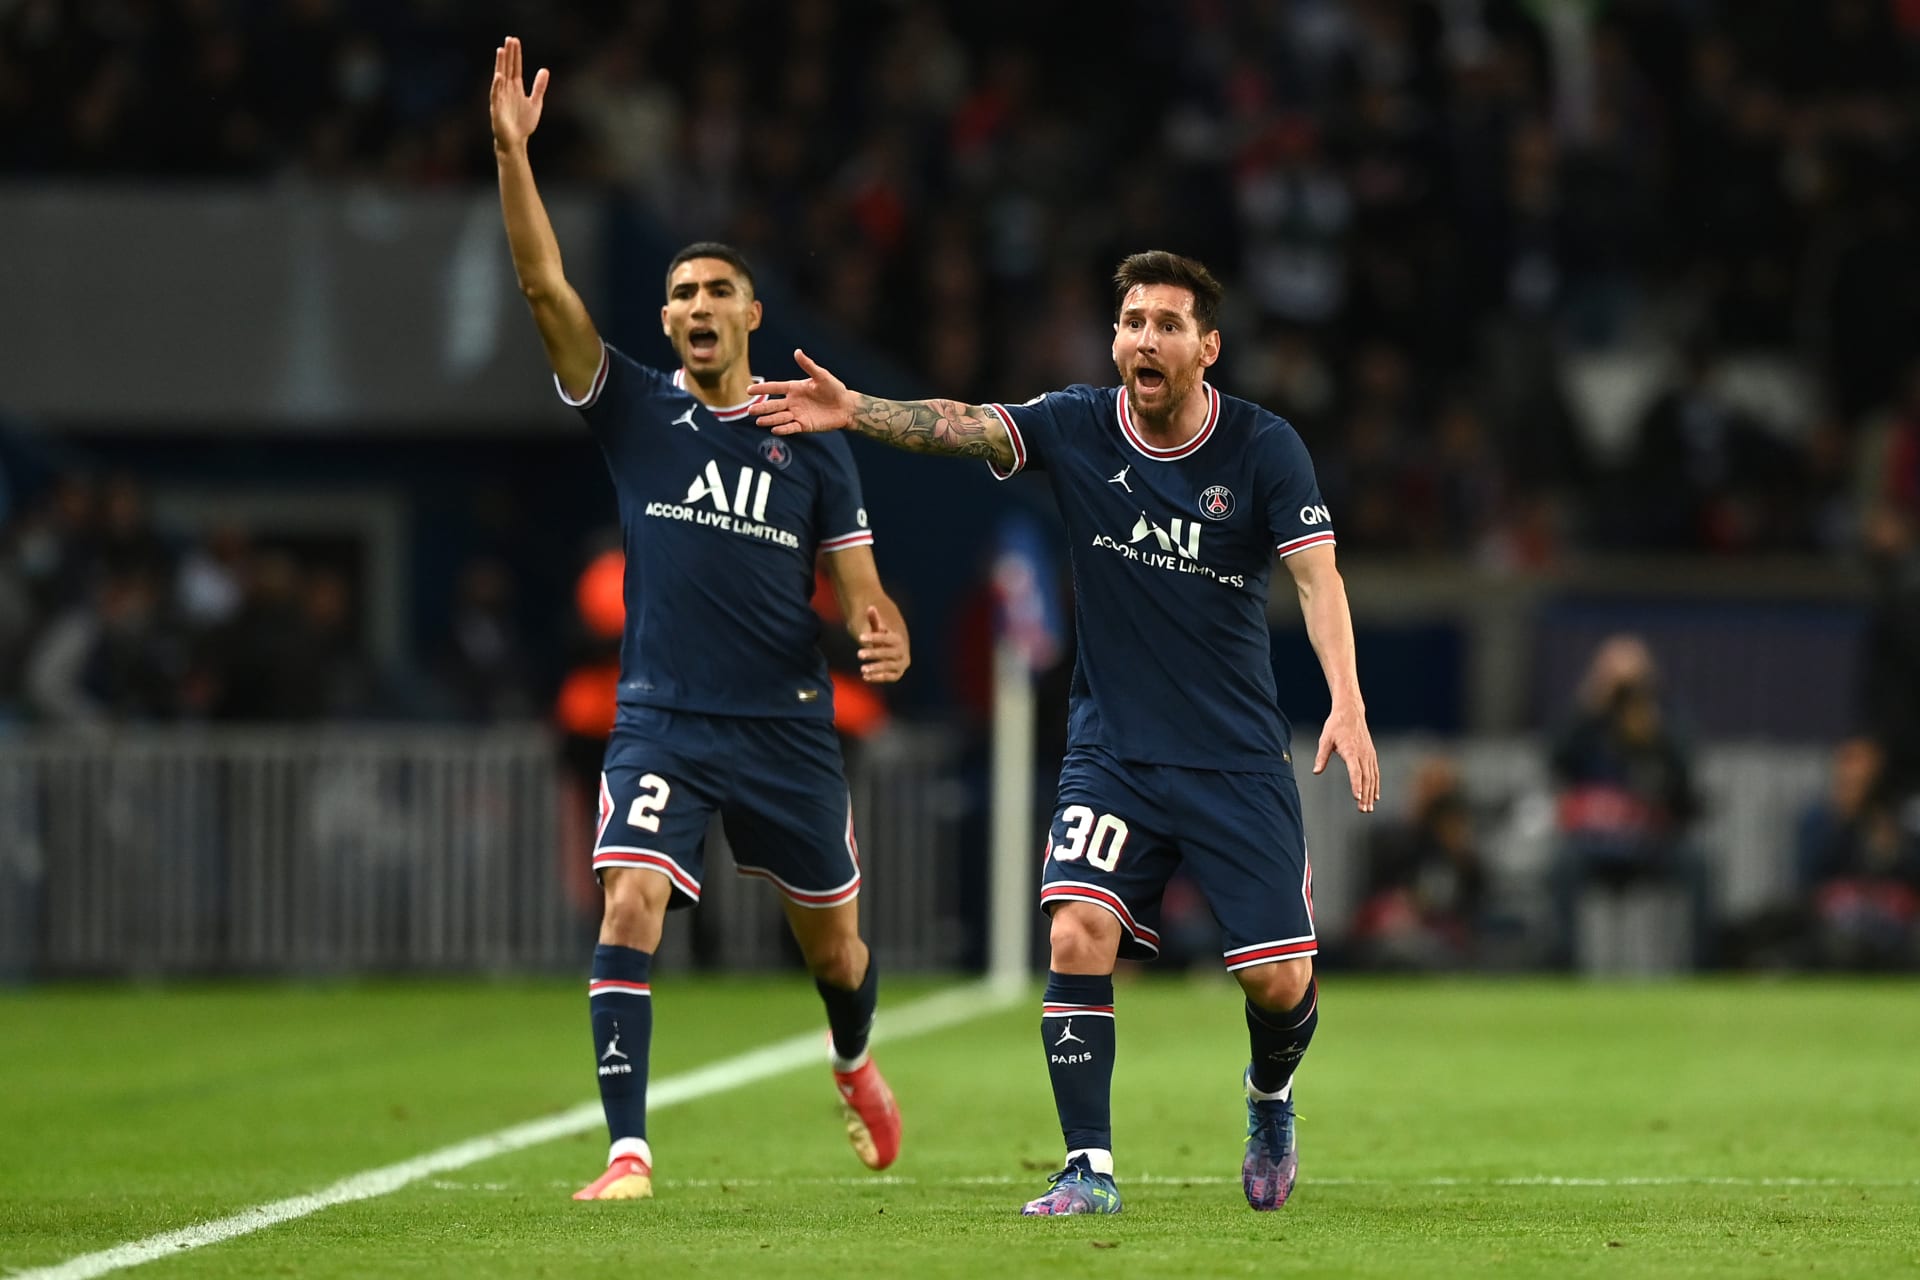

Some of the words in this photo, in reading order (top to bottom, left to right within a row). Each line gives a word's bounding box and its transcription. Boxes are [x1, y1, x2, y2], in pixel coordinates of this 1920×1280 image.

[645, 502, 694, 522] ACCOR
[696, 510, 731, 530] LIVE
[733, 519, 799, 549] LIMITLESS
[1142, 552, 1176, 570] LIVE
[1179, 559, 1244, 587] LIMIESS
[626, 773, 671, 833] 2
[1053, 805, 1129, 873] 30
[1051, 1051, 1092, 1064] PARIS
